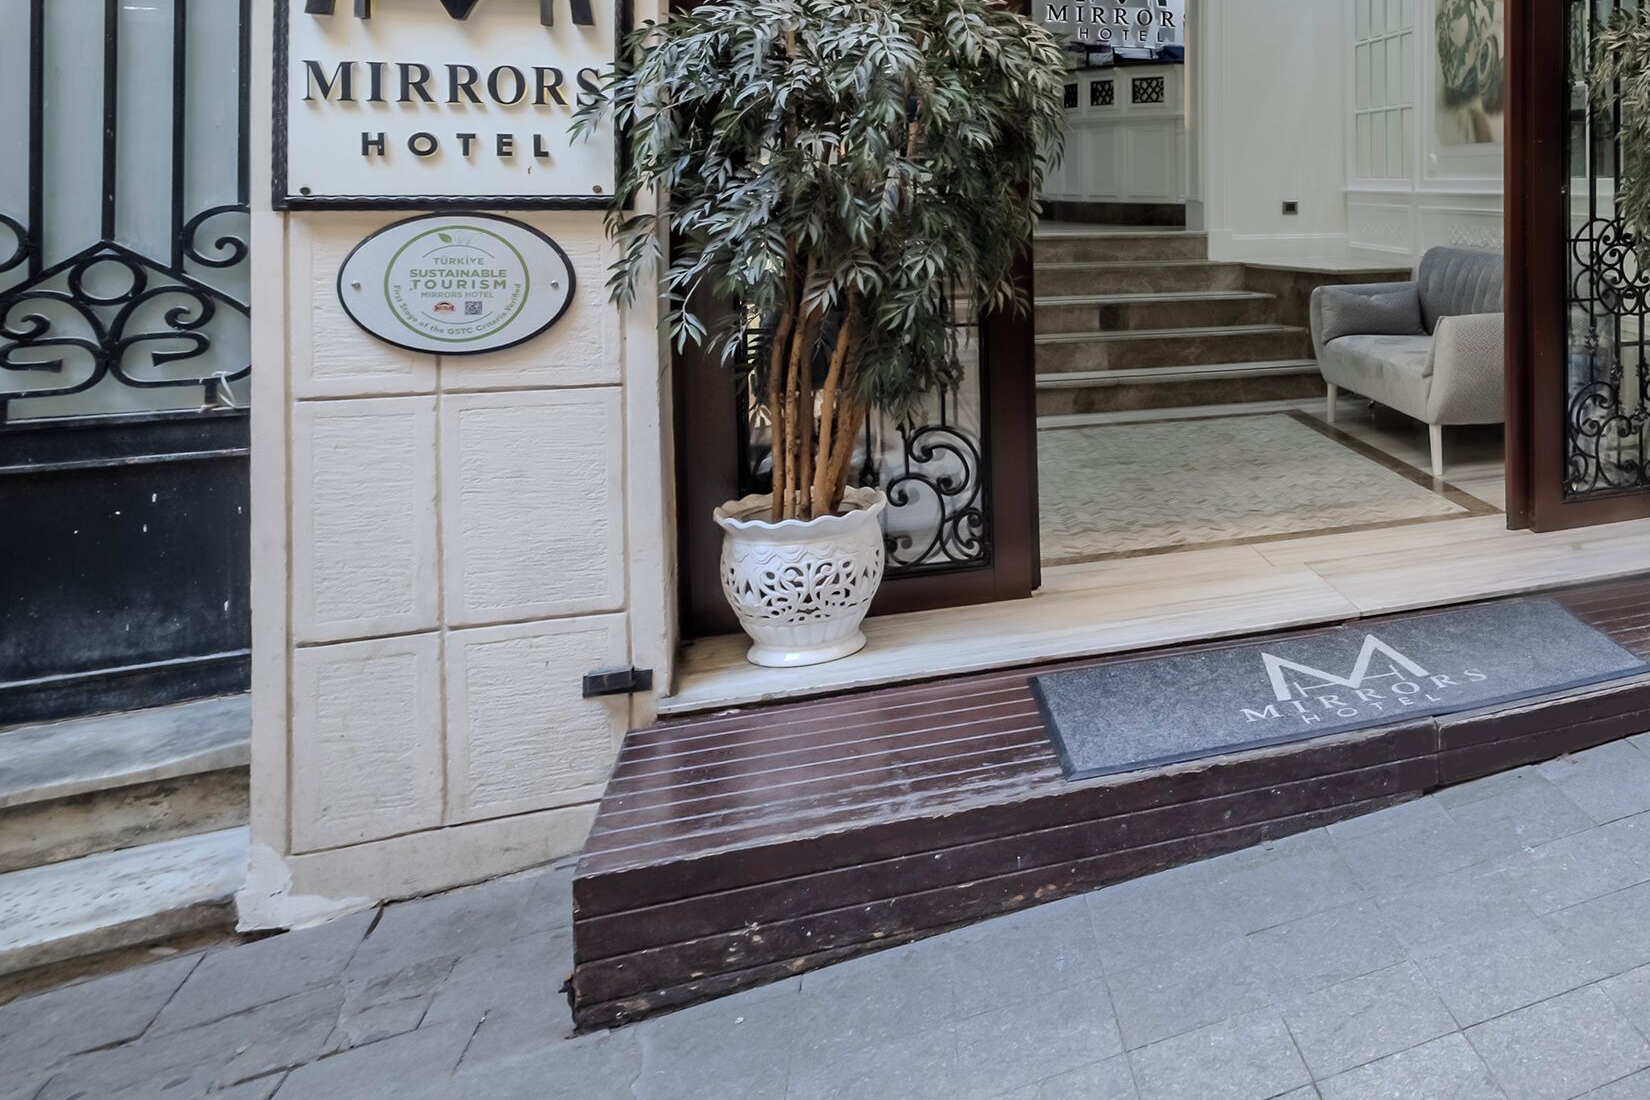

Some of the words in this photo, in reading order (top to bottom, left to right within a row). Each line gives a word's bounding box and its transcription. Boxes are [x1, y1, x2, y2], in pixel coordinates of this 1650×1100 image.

[1047, 3, 1185, 28] MIRROR
[1078, 28, 1164, 43] HOTEL
[302, 60, 601, 107] MIRRORS
[361, 132, 550, 157] HOTEL
[432, 255, 484, 265] TÜRKİYE
[409, 269, 507, 278] SUSTAINABLE
[412, 279, 507, 290] TOURISM
[420, 291, 463, 299] MIRRORS
[400, 302, 418, 323] Stage
[420, 321, 429, 329] of
[430, 325, 445, 334] the
[475, 312, 507, 331] Criteria
[1240, 668, 1487, 723] MIRRORS
[1301, 694, 1442, 724] HOTEL
